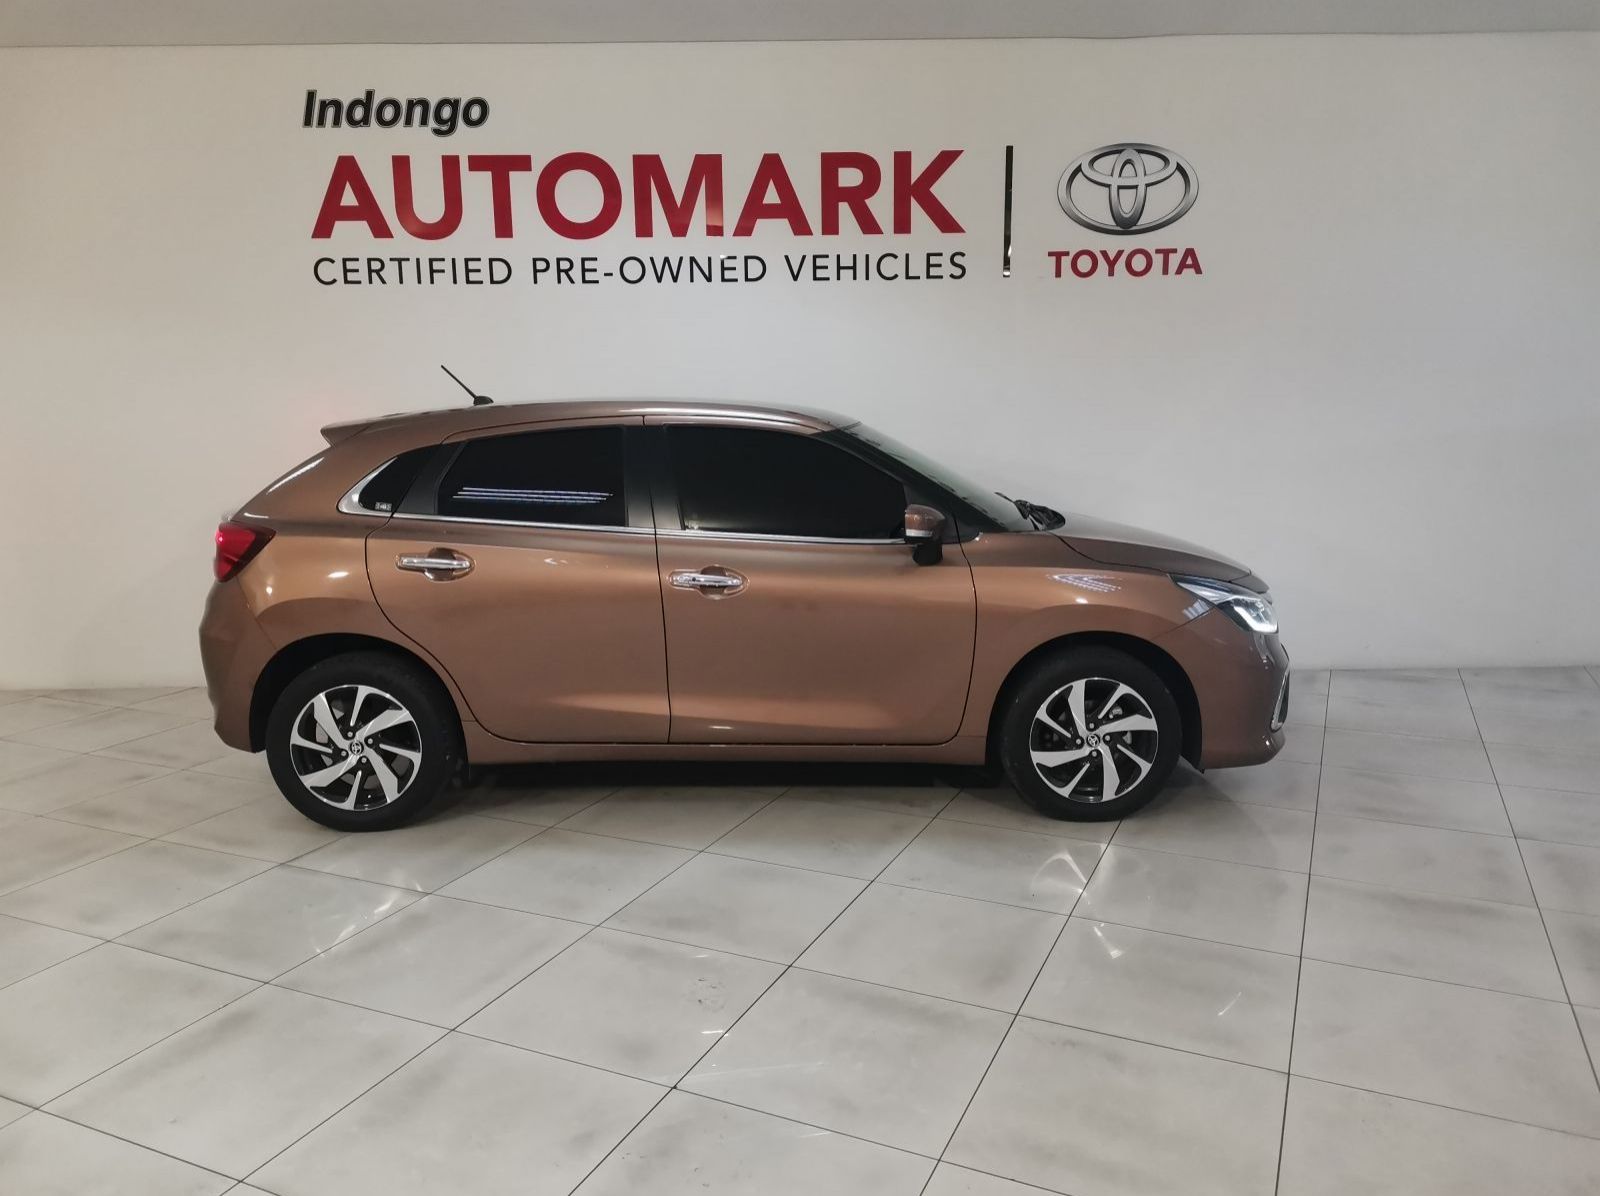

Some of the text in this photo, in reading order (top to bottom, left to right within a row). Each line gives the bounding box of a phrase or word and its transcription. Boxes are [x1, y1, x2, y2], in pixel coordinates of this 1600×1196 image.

[302, 88, 490, 138] Indongo
[311, 150, 966, 241] AUTOMARK
[313, 251, 967, 286] CERTIFIED PRE-OWNED VEHICLES
[1048, 247, 1203, 279] TOYOTA
